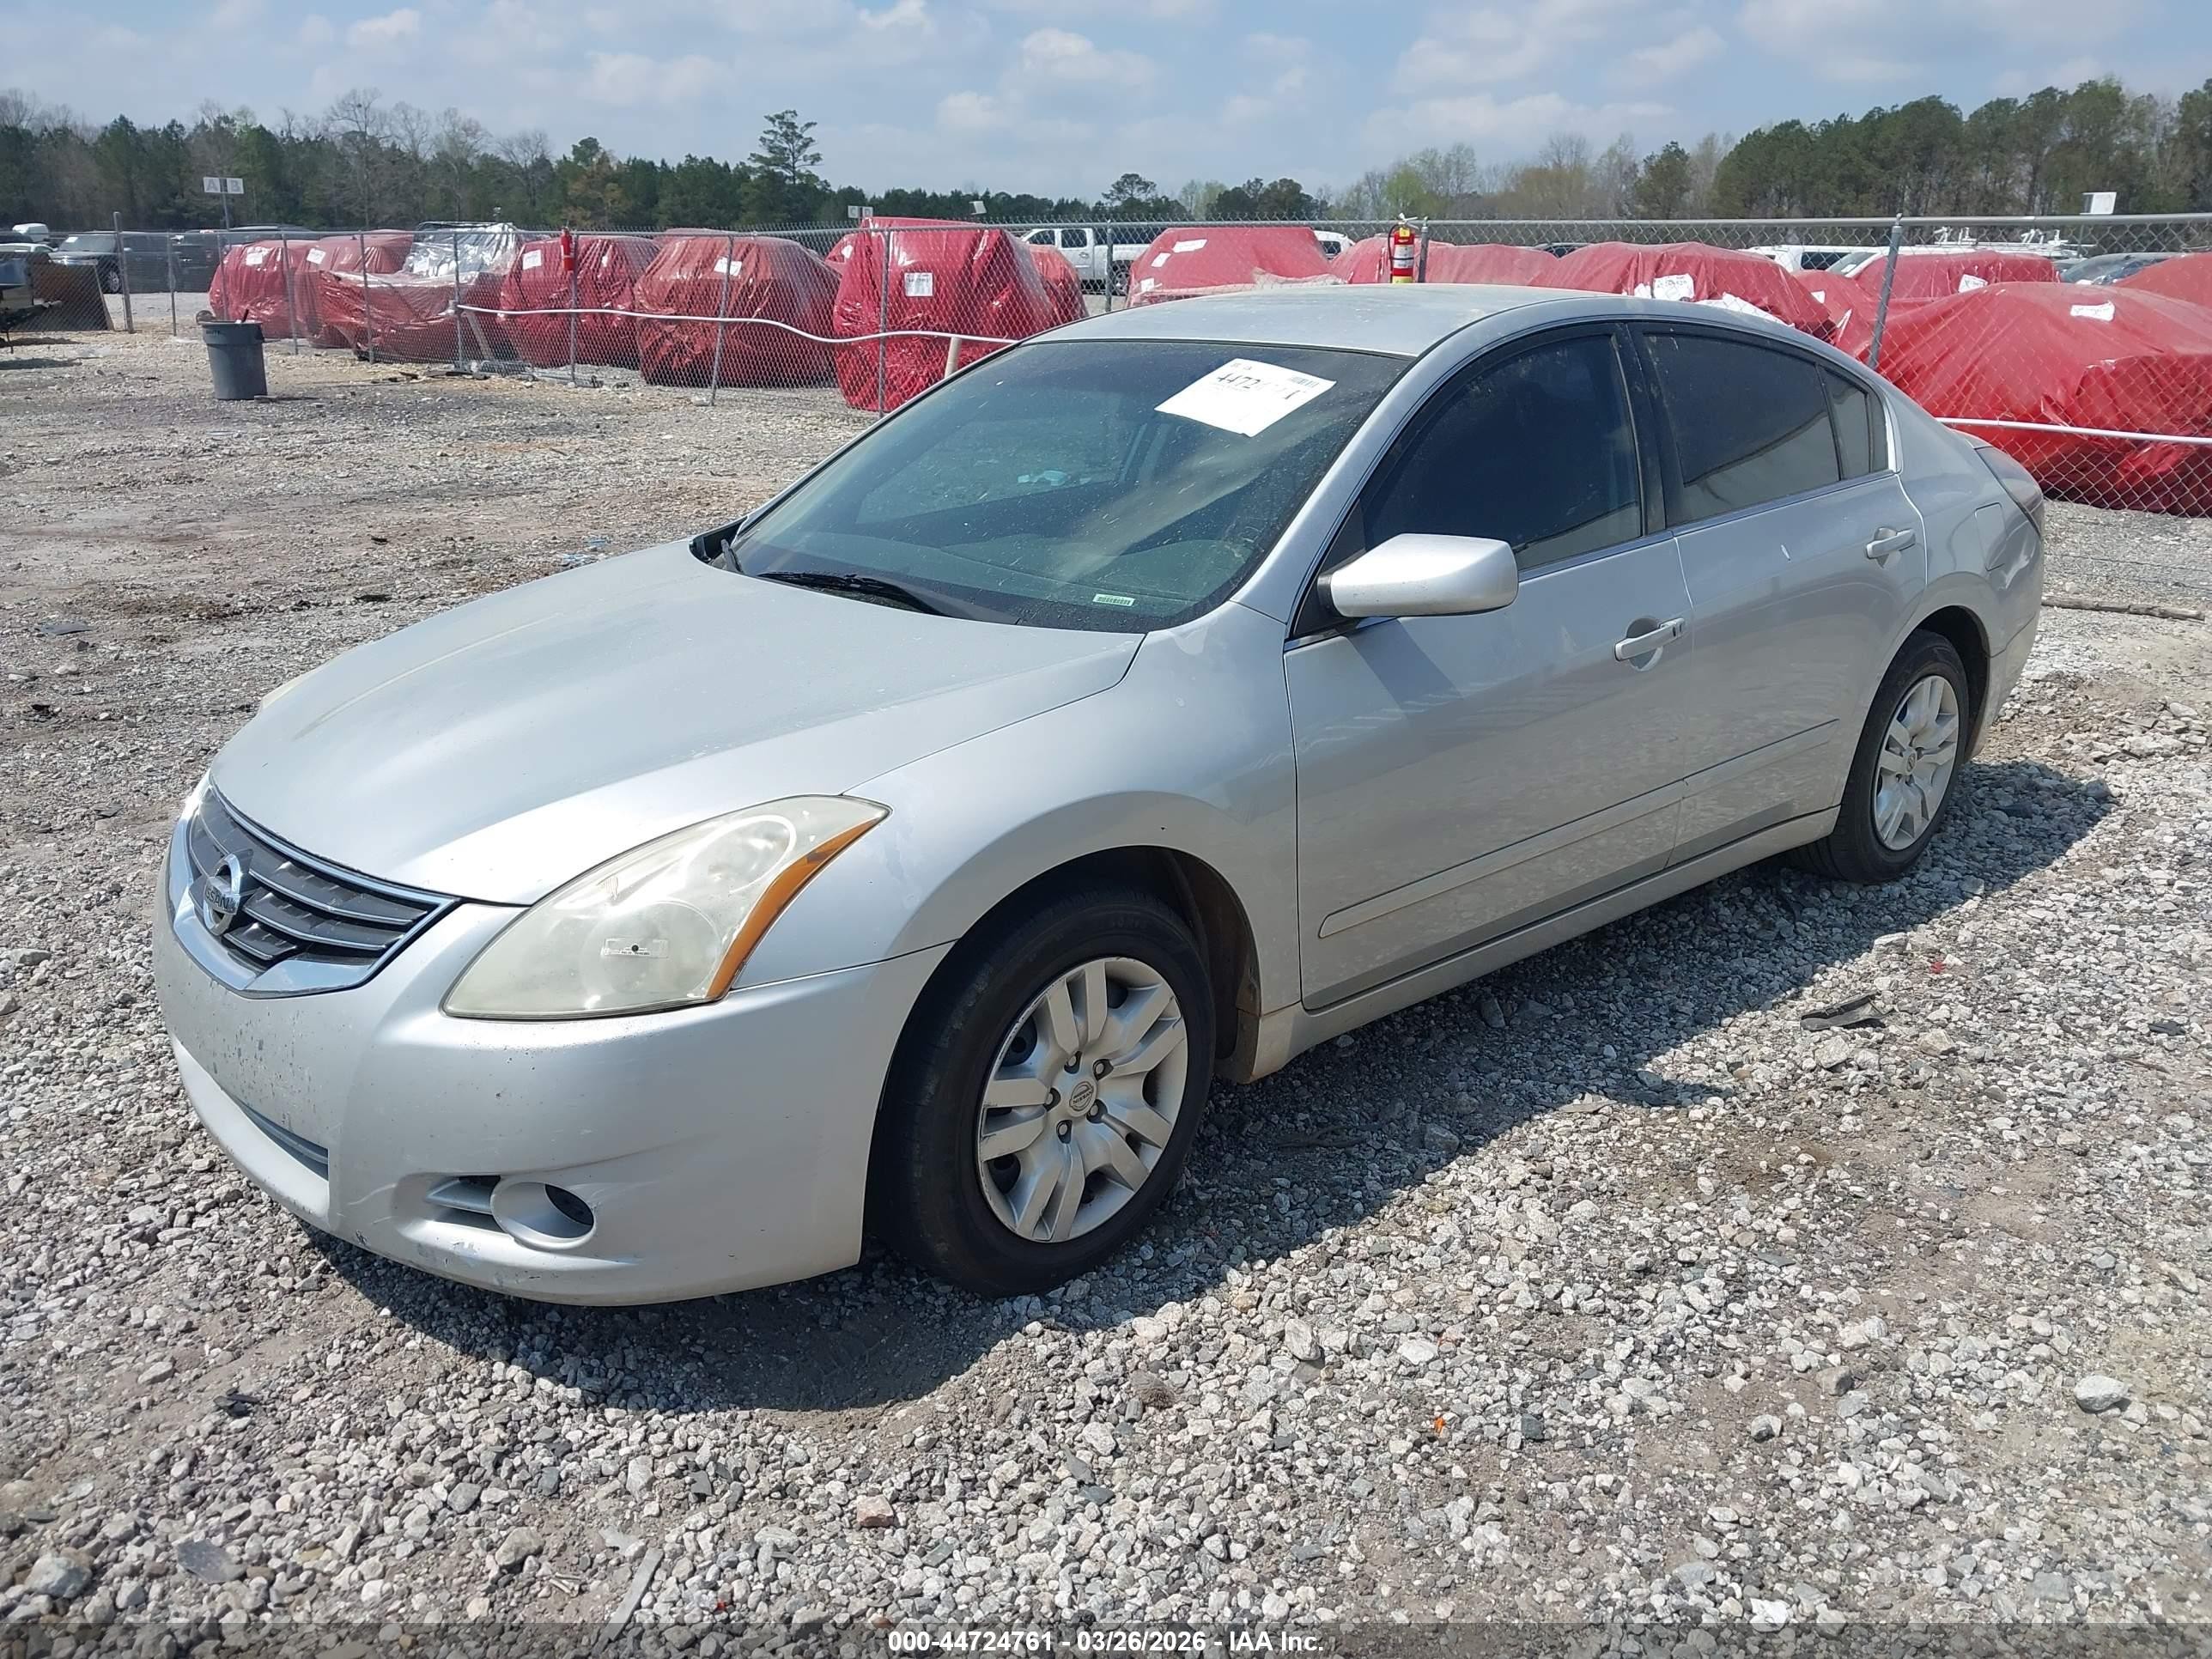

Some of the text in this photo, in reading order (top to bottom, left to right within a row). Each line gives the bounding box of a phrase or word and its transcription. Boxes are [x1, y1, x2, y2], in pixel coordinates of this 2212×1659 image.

[206, 179, 241, 192] A B
[1073, 1090, 1092, 1104] NISSAN
